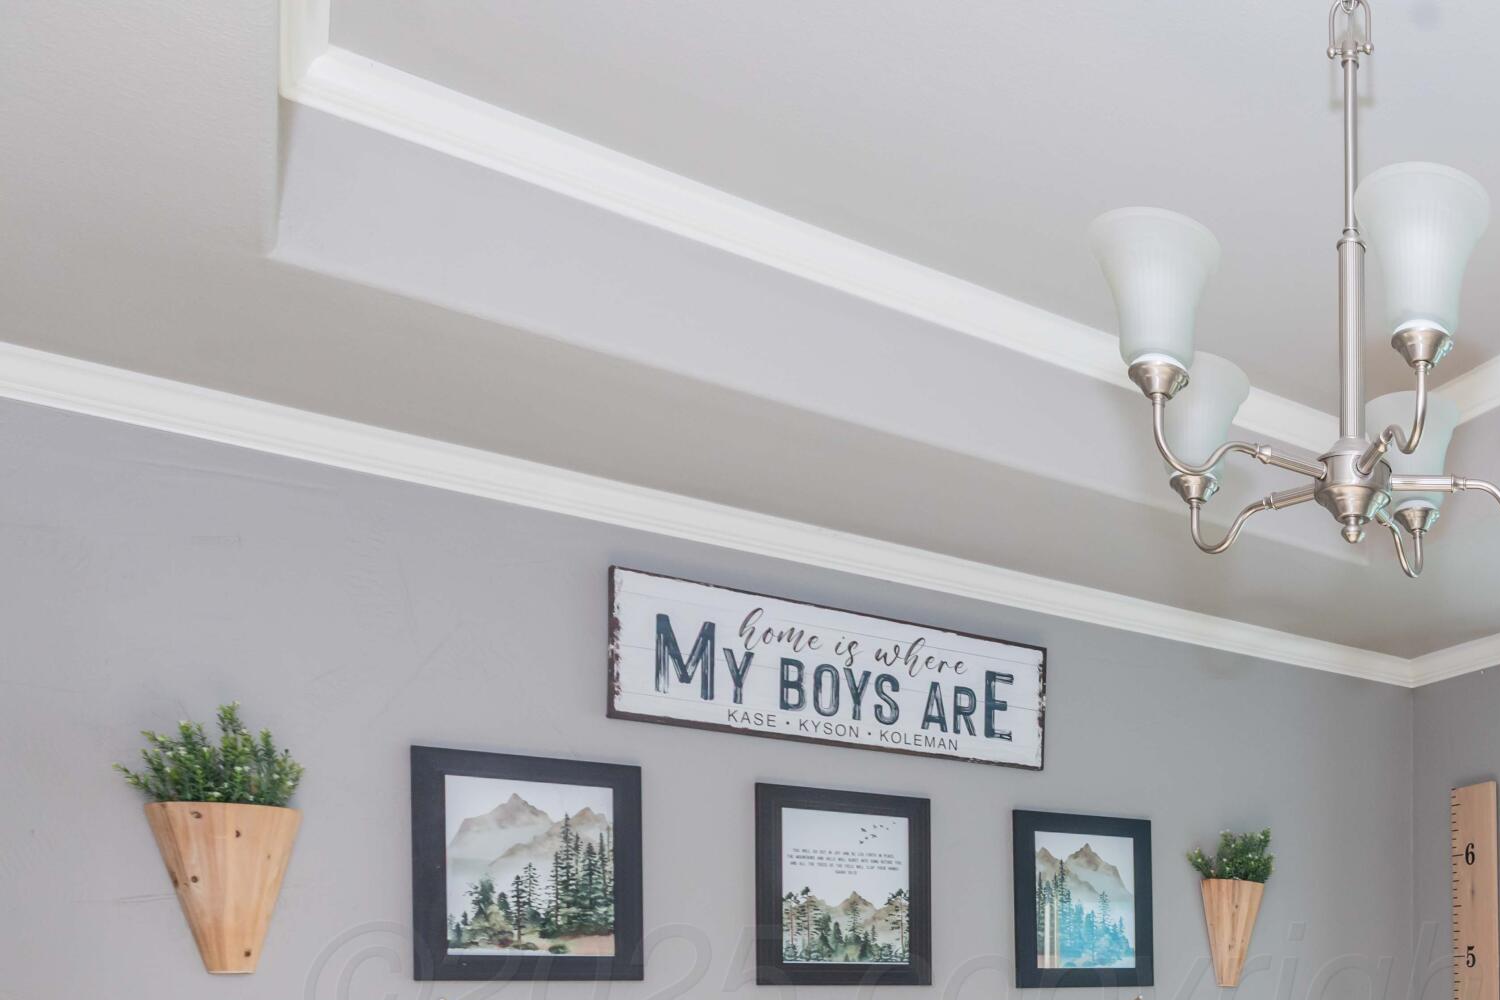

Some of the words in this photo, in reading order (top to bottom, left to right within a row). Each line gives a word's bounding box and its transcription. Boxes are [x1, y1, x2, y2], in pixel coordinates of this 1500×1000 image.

[738, 607, 823, 651] home
[834, 635, 859, 667] is
[874, 636, 969, 678] where
[779, 656, 900, 726] BOYS
[920, 669, 1015, 742] ARE
[727, 708, 777, 728] KASE
[798, 719, 860, 739] KYSON
[879, 729, 959, 752] KOLEMAN
[1464, 842, 1476, 866] 6
[1465, 945, 1476, 968] 5
